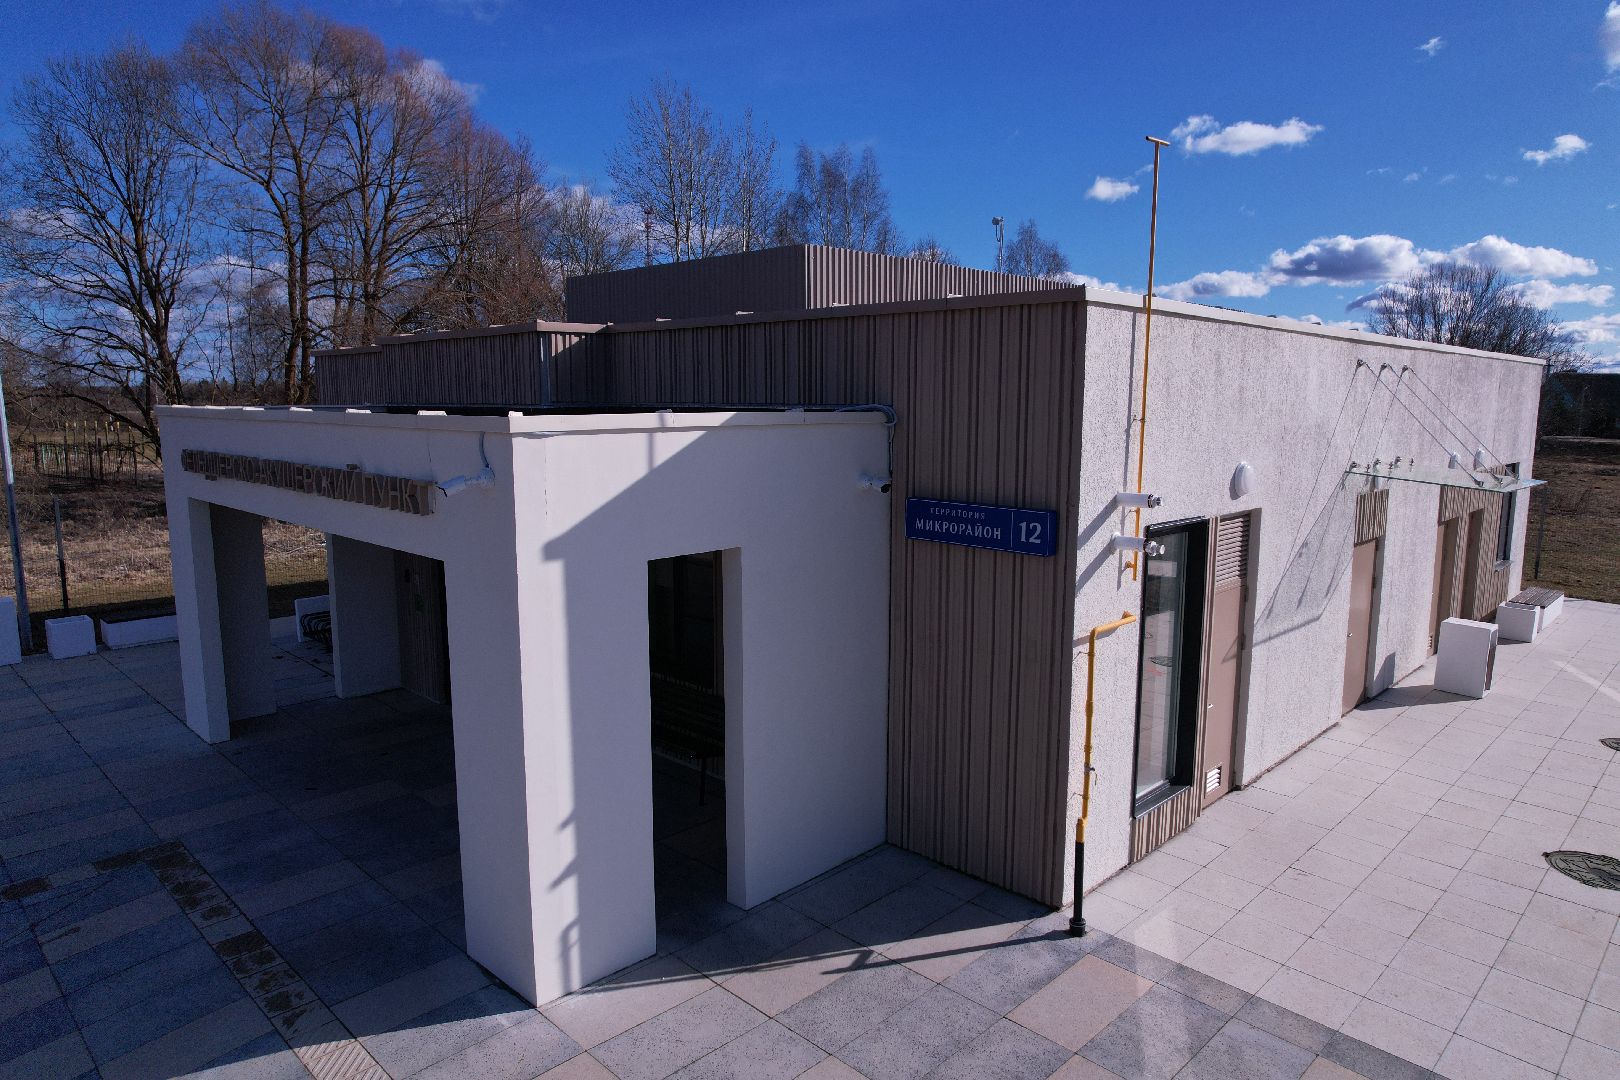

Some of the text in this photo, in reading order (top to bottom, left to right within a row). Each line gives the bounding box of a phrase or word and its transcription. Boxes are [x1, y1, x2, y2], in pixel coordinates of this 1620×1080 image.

[361, 472, 430, 516] ПУНКТ
[930, 507, 985, 520] ТЕРРИТОРИЯ
[915, 518, 1042, 544] МИКРОРАЙОН 12
